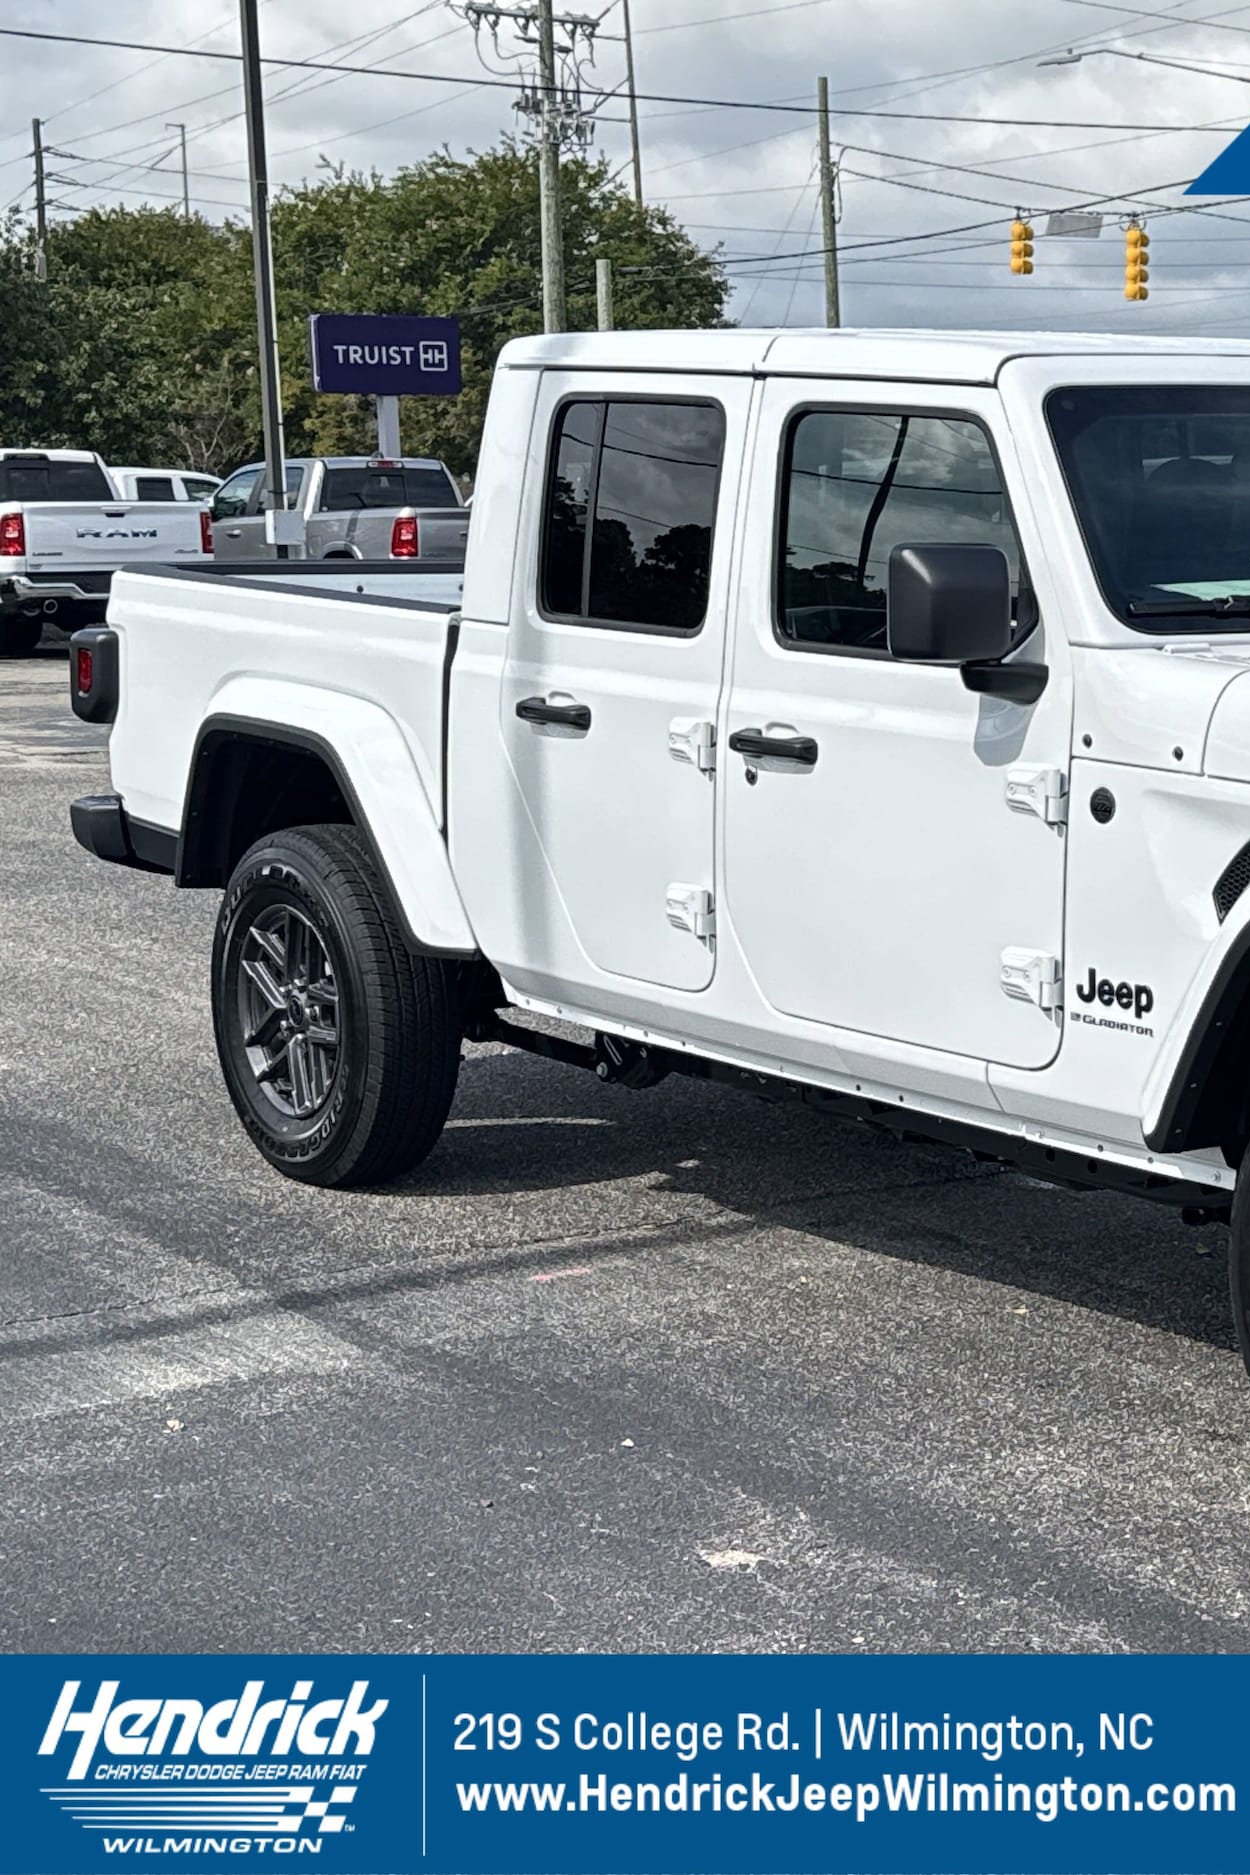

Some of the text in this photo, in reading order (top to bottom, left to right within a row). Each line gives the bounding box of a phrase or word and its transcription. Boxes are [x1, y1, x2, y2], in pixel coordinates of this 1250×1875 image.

[333, 345, 415, 365] TRUIST
[76, 528, 157, 538] RAM
[1076, 967, 1154, 1019] Jeep
[1082, 1014, 1154, 1038] GLADIATOR
